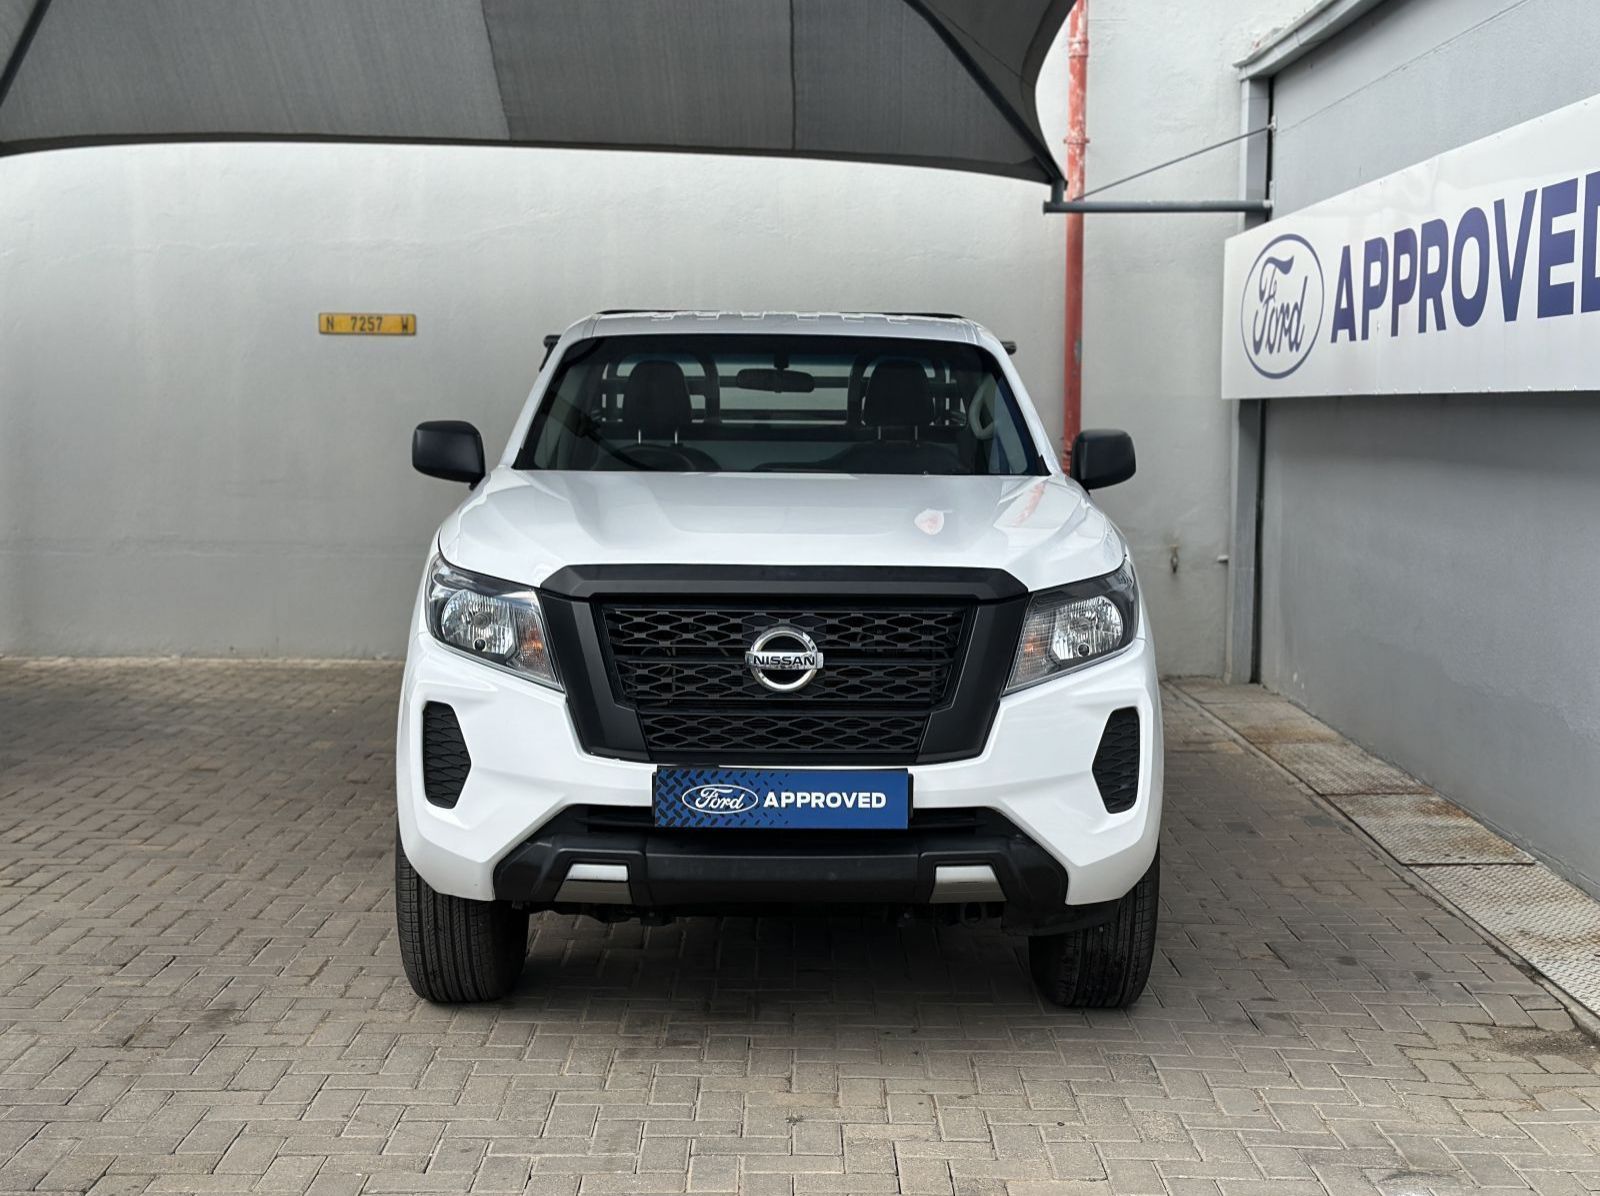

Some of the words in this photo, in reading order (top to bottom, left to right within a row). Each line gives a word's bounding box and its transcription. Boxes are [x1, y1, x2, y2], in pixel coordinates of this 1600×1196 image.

[1252, 255, 1308, 355] Ford
[326, 316, 335, 331] N
[350, 316, 383, 331] 7257
[753, 656, 815, 666] NISSAN
[695, 787, 745, 810] Ford
[763, 792, 887, 809] APPROVED
